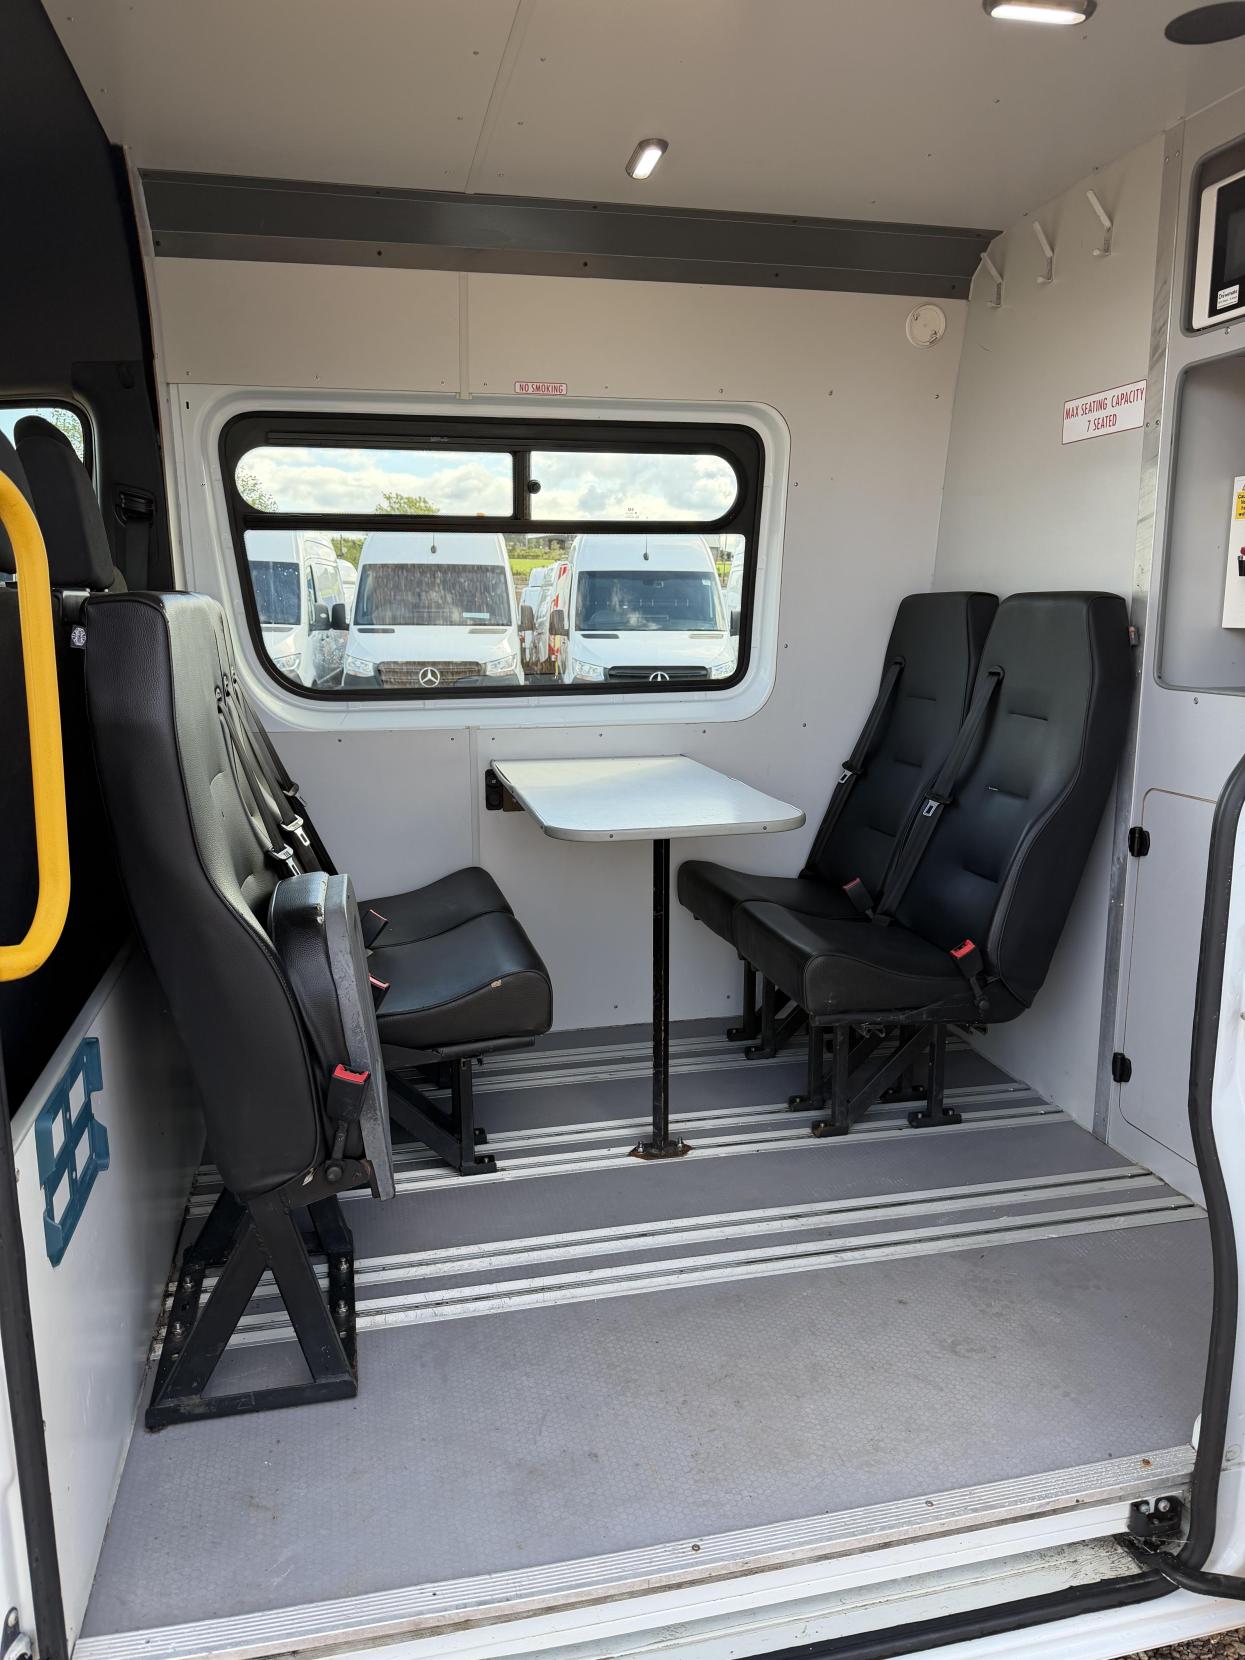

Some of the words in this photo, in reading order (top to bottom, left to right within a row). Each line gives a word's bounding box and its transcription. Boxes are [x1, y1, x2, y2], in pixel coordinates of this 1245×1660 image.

[519, 383, 529, 393] NO
[531, 383, 564, 394] SMOKING
[1064, 405, 1079, 420] MAX
[1080, 397, 1108, 416] SEATING
[1111, 387, 1145, 408] CAPACITY
[1086, 420, 1091, 432] 7
[1093, 413, 1117, 431] SEATED
